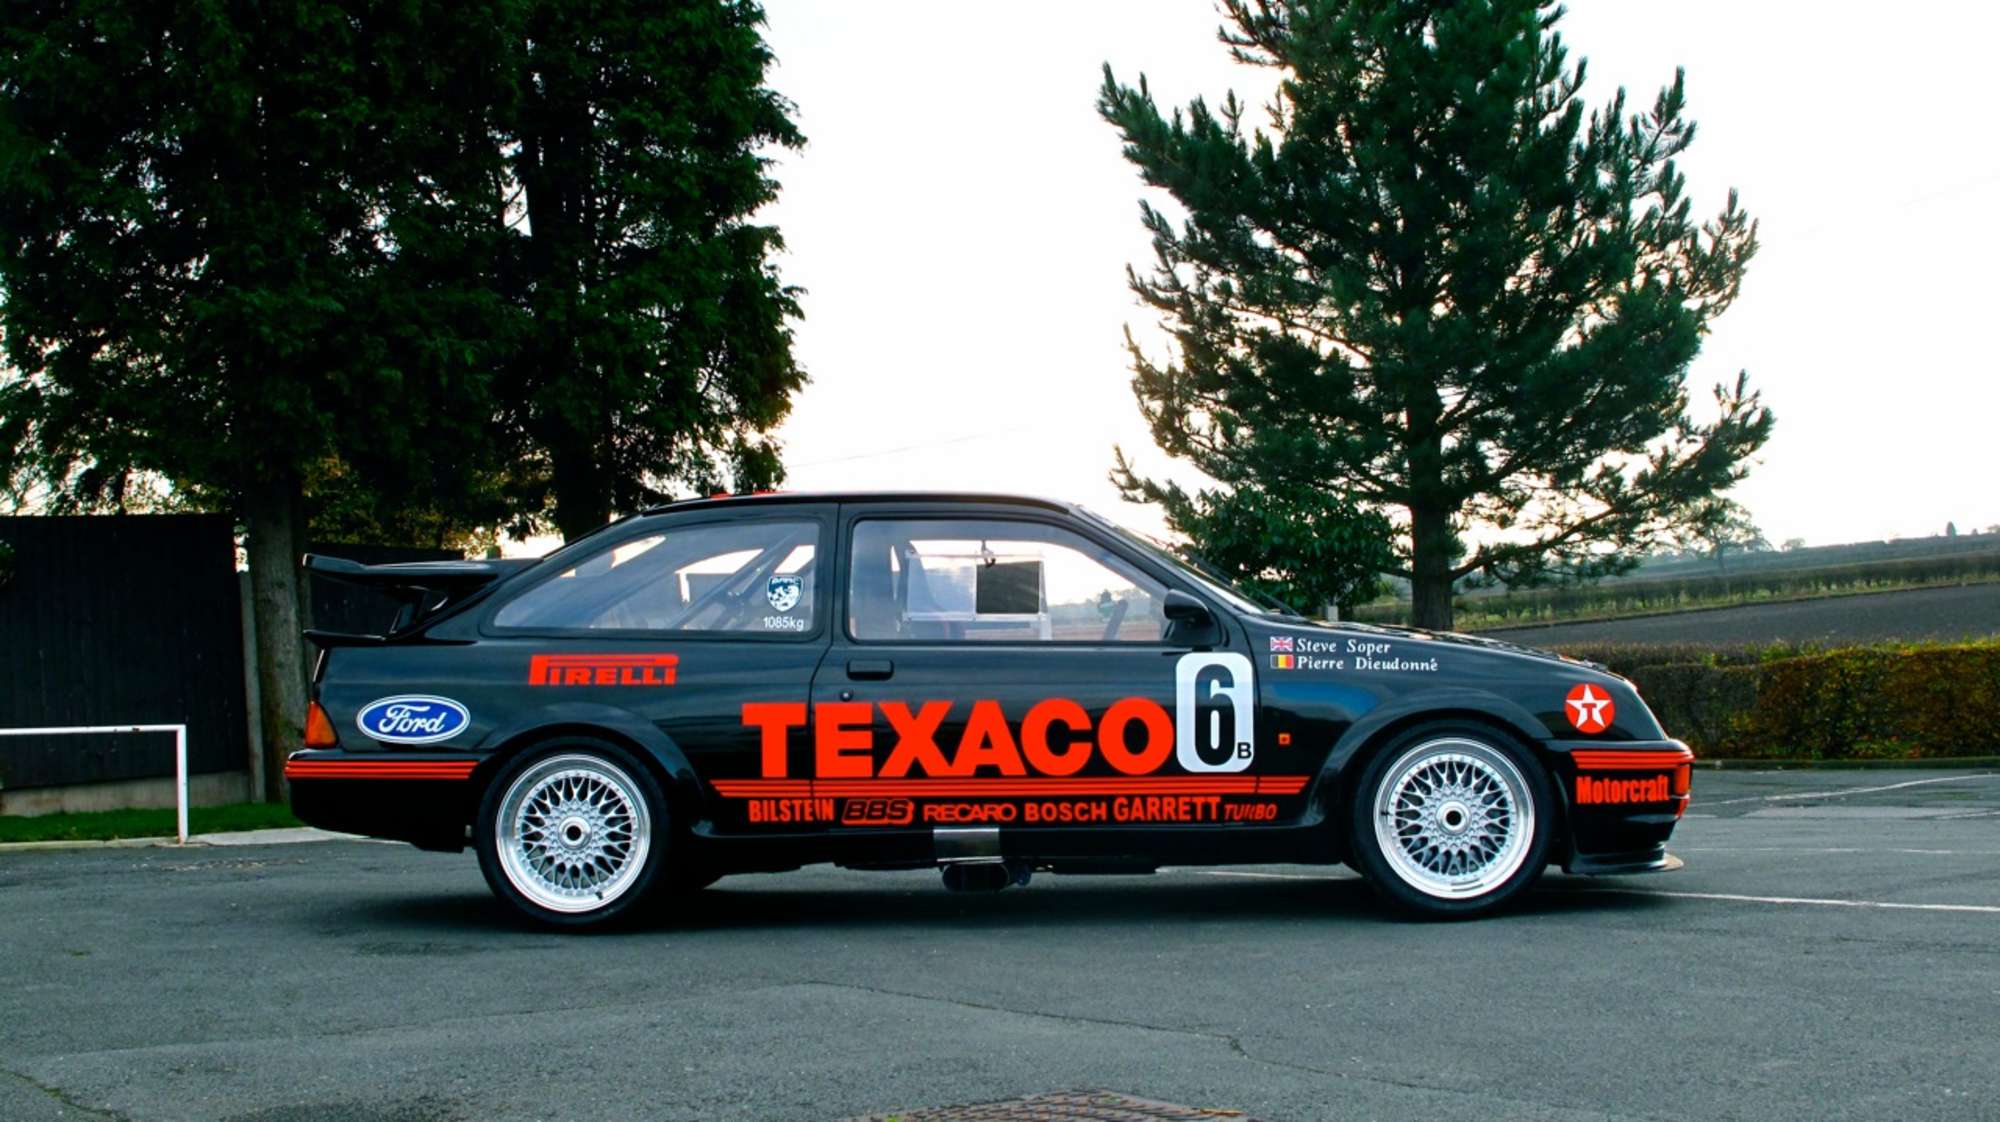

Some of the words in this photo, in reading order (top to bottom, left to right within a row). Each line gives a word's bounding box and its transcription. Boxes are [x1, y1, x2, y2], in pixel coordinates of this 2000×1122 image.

[763, 616, 804, 632] 1085kg
[1296, 638, 1337, 653] Steve
[1346, 639, 1391, 657] Soper
[528, 654, 679, 686] PIRELLI
[1297, 656, 1344, 670] Pierre
[1355, 656, 1438, 672] Dieudonné
[378, 705, 448, 734] Ford
[1195, 663, 1236, 767] 6
[742, 696, 1175, 778] TEXACO
[1237, 742, 1252, 759] B
[1576, 775, 1670, 804] Motorcraft
[748, 799, 835, 823] BILSTEIN
[844, 800, 913, 823] BBS
[923, 804, 1017, 822] RECARO
[1024, 803, 1107, 822] BOSCH
[1113, 797, 1221, 821] GARRETT
[1224, 804, 1277, 821] TURBO
